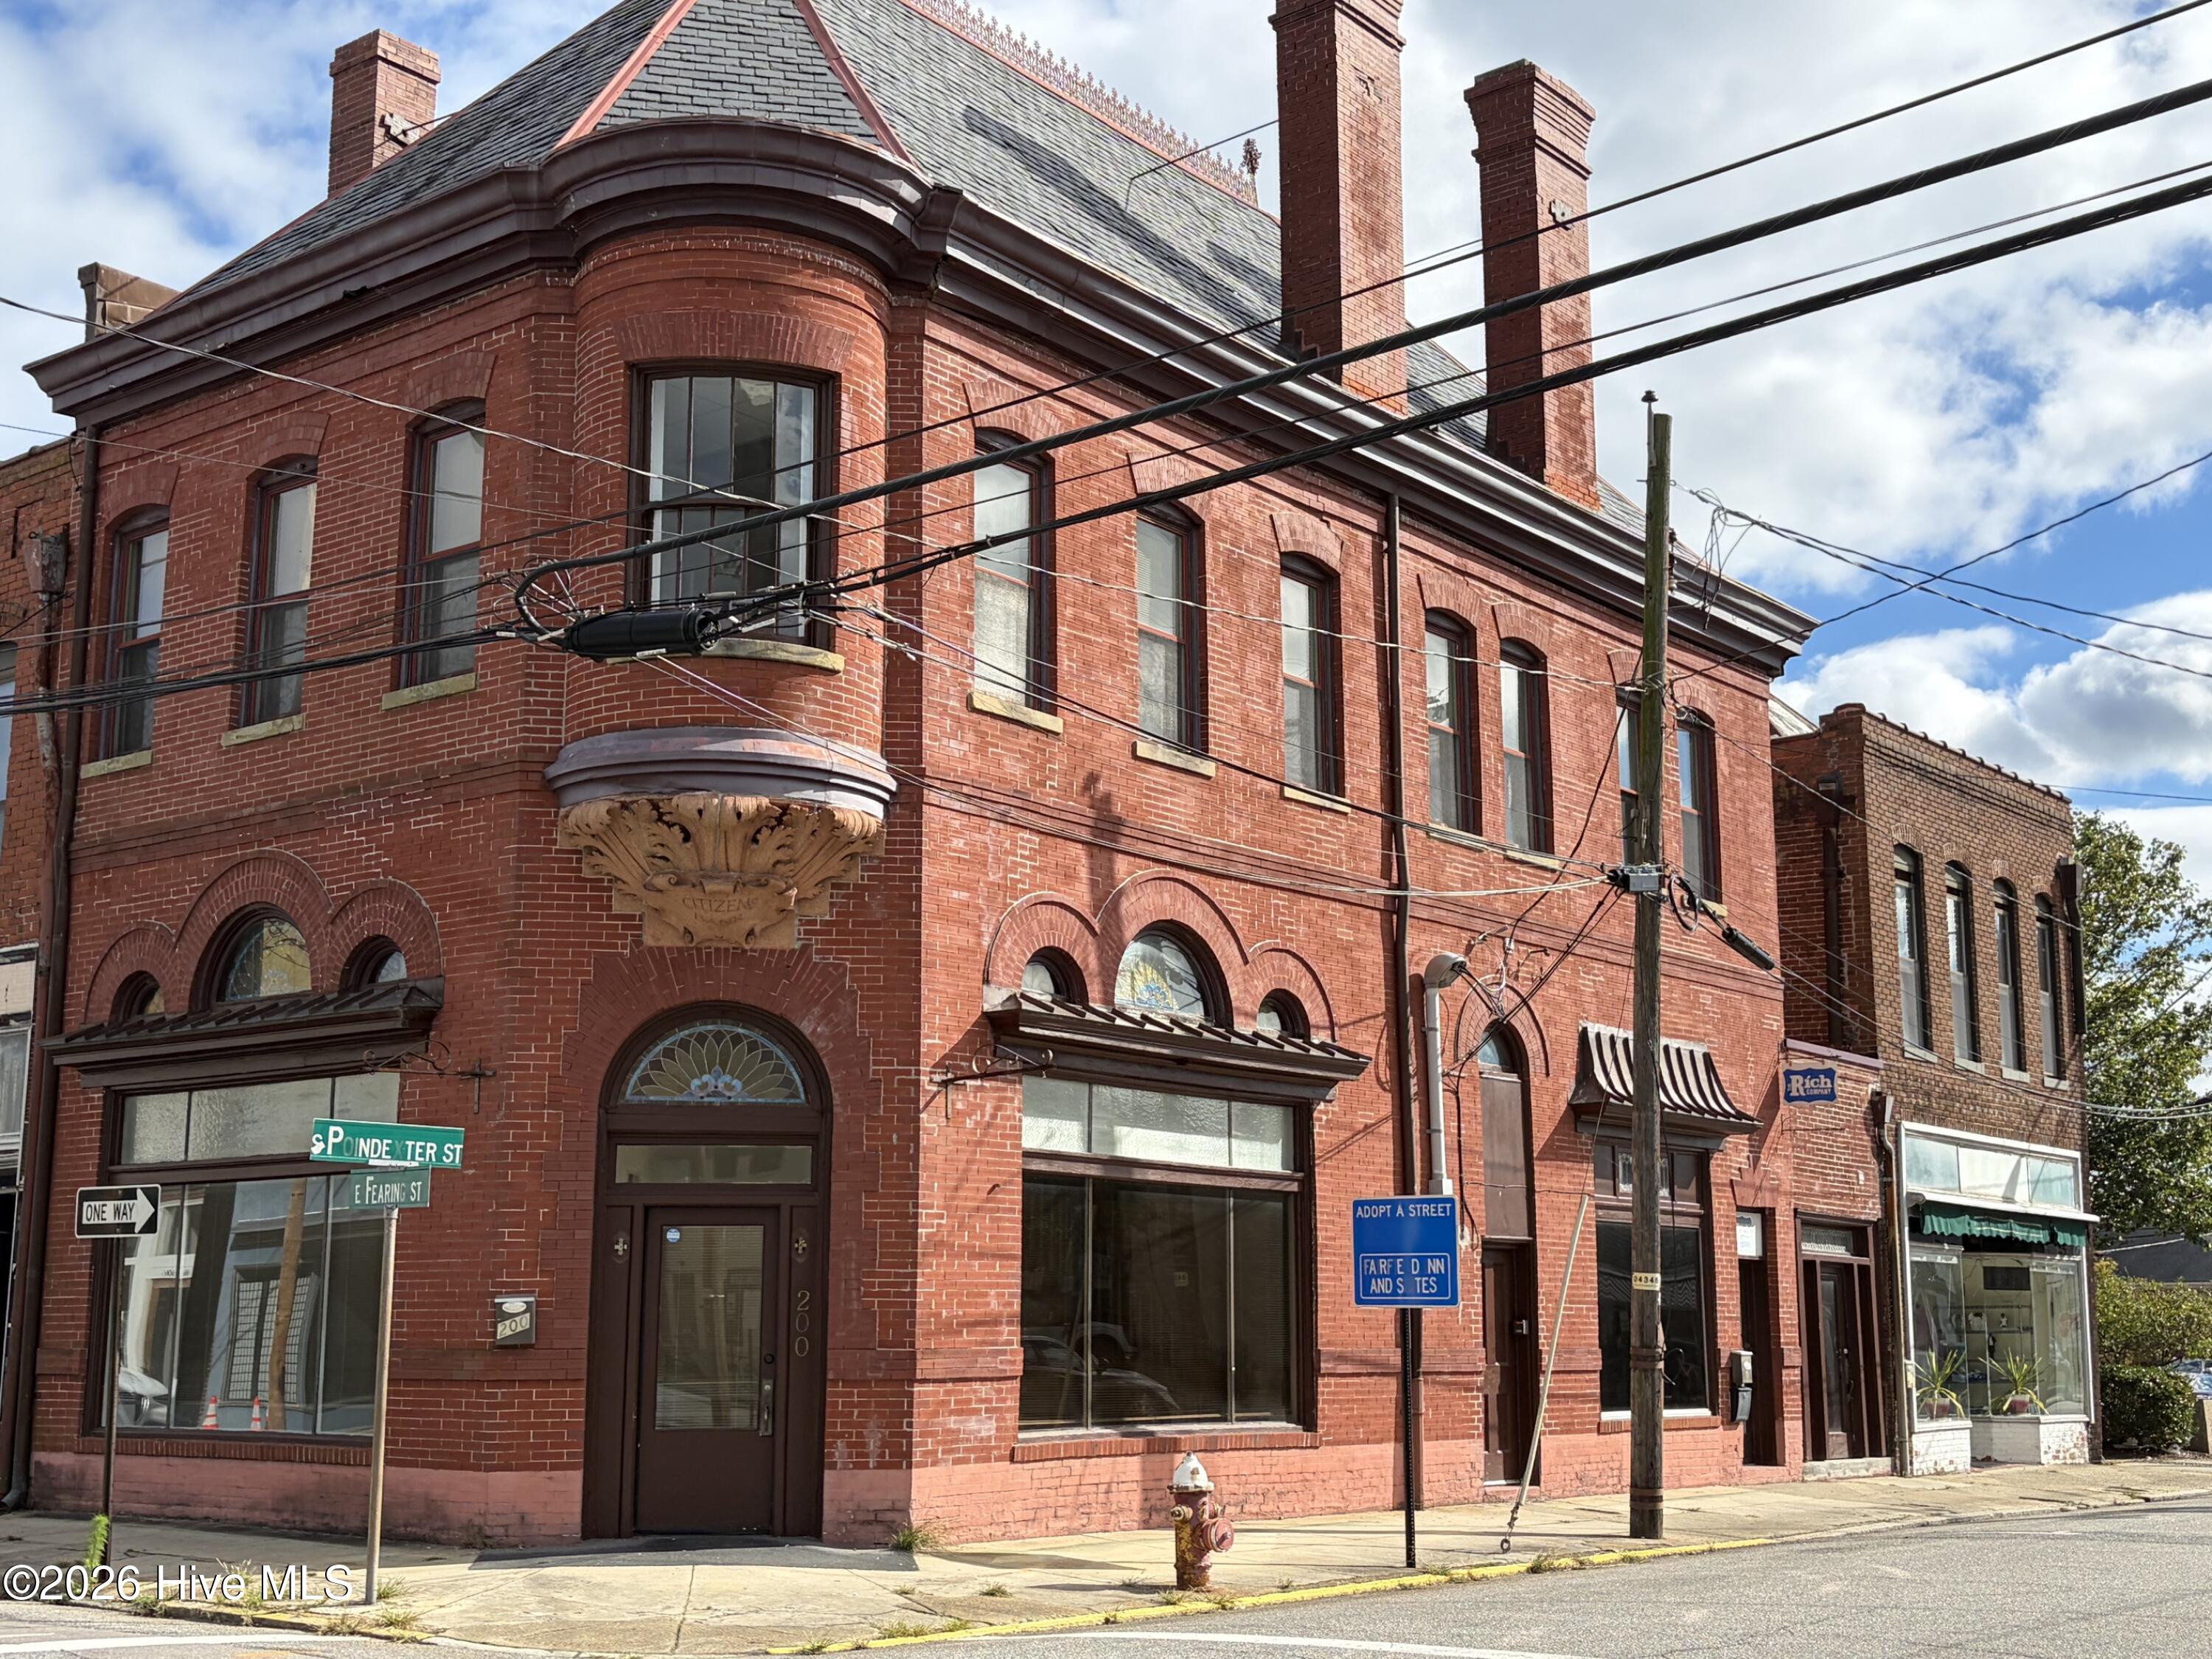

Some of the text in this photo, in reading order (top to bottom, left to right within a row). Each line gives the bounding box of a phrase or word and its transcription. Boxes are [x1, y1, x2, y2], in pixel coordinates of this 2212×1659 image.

[1790, 1074, 1832, 1096] Rich
[442, 1143, 464, 1164] ST
[355, 1176, 422, 1204] E FEARING ST
[86, 1202, 136, 1222] ONE WAY
[1356, 1203, 1452, 1218] ADOPT A STREET
[1370, 1278, 1393, 1294] AND
[499, 1315, 529, 1336] 200
[796, 1290, 810, 1357] 200
